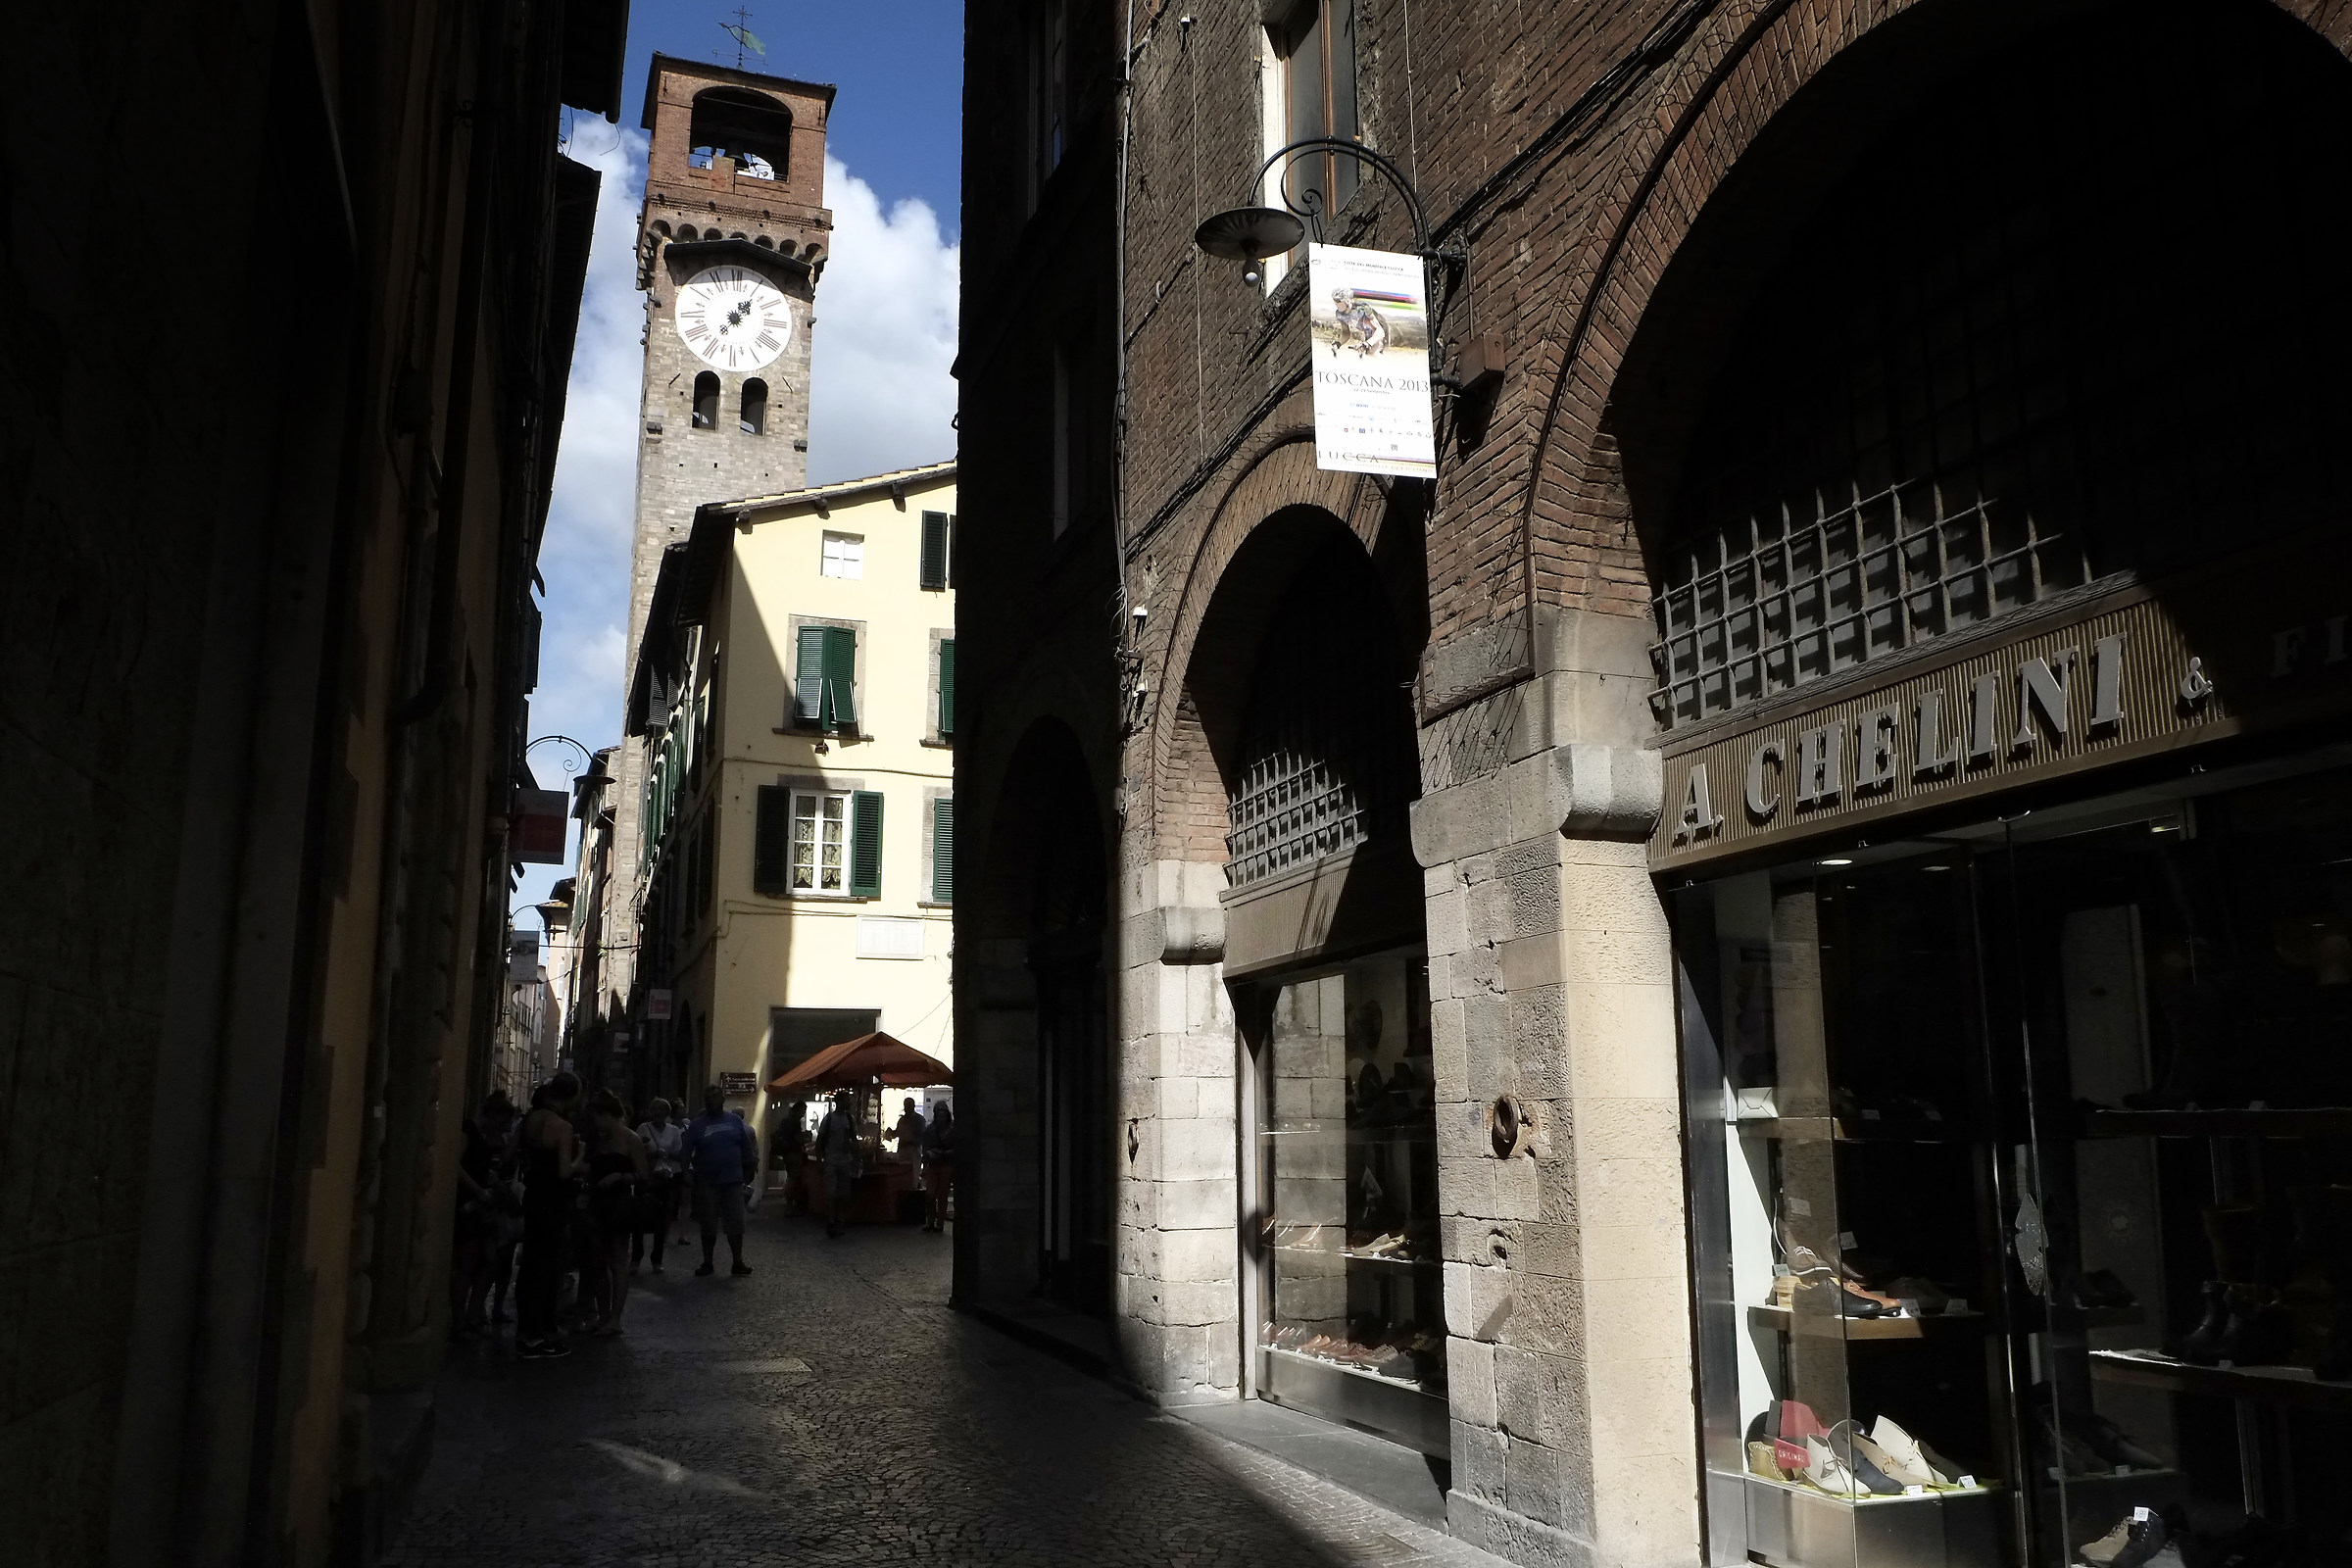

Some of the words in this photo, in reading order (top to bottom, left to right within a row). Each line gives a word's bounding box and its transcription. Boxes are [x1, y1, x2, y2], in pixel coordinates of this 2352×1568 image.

[1315, 370, 1394, 389] TOSCANA
[1398, 378, 1429, 392] 2013
[1744, 632, 2128, 815] CHELINI
[2180, 656, 2214, 700] &
